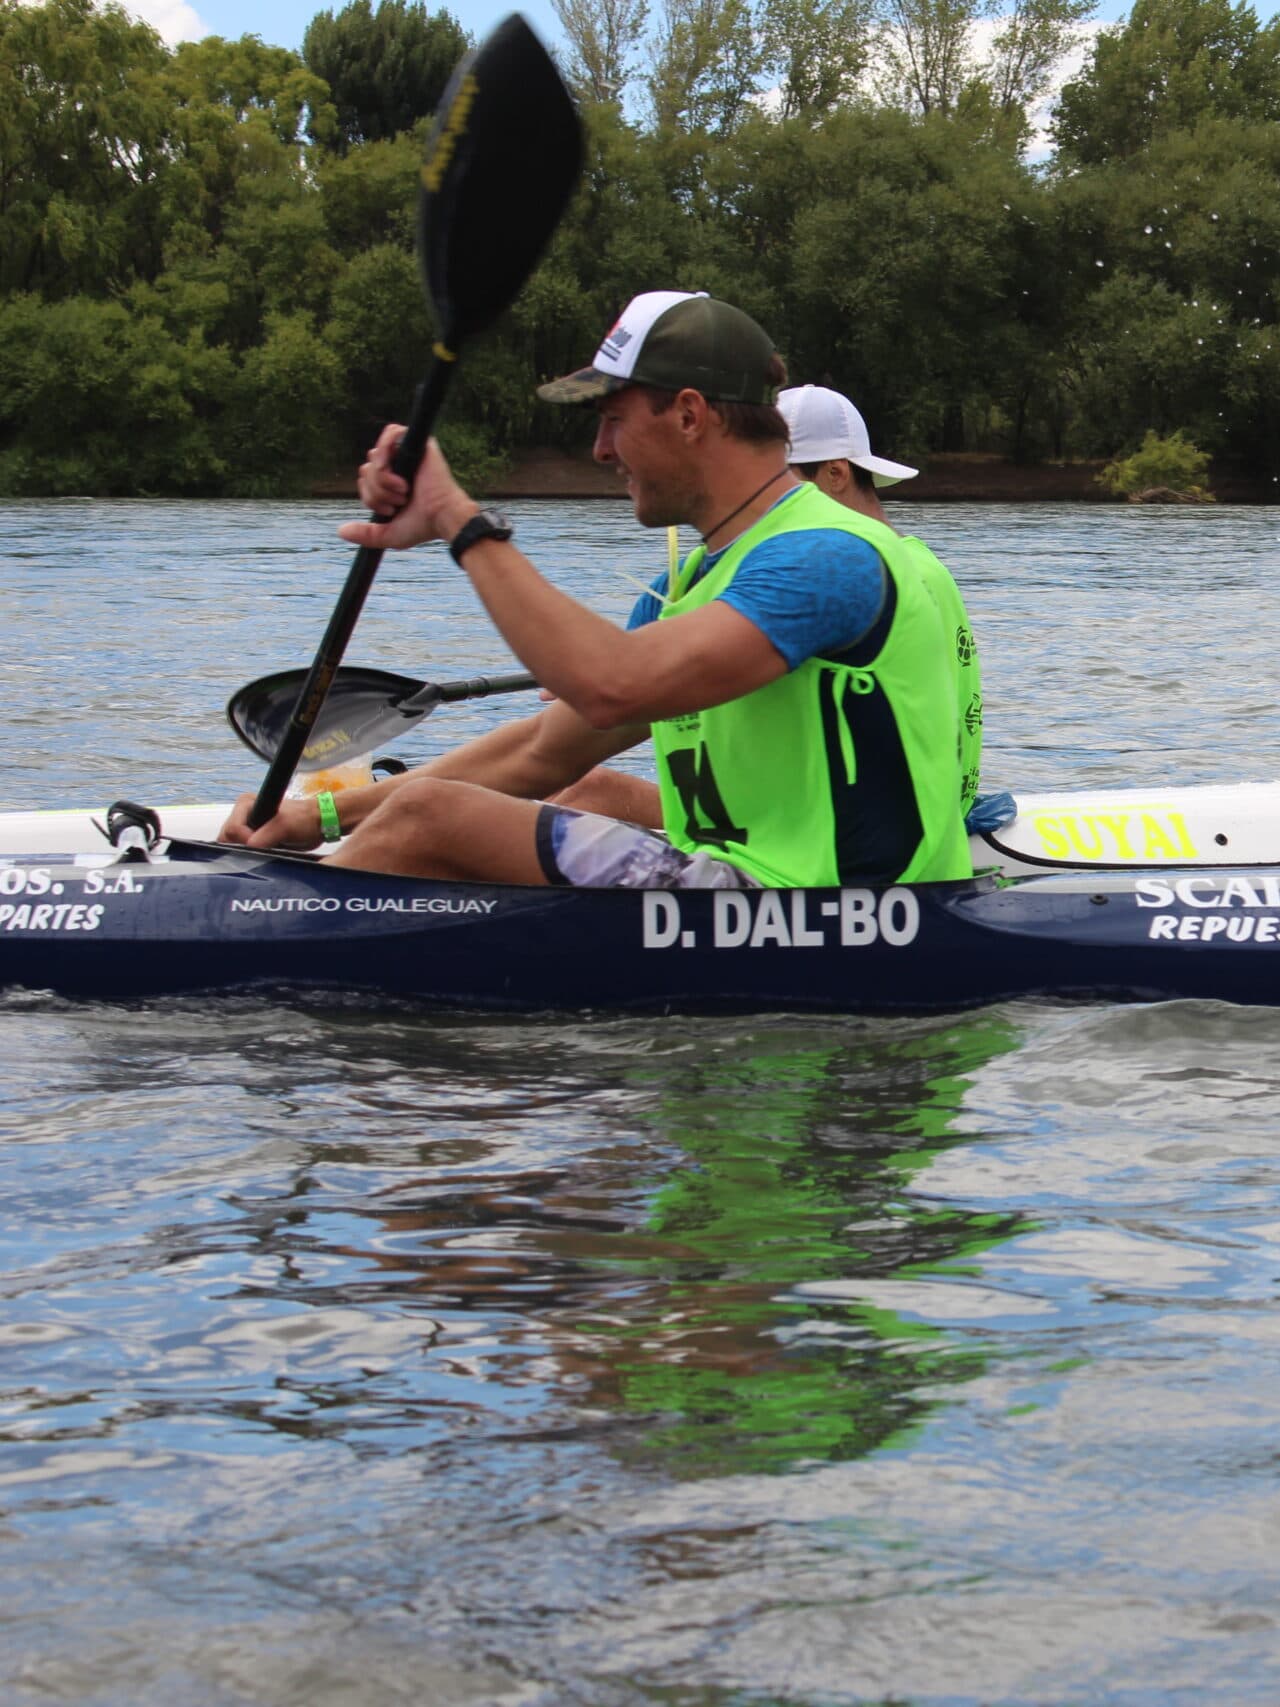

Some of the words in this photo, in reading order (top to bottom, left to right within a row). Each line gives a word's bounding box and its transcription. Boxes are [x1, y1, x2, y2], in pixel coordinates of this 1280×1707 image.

[1034, 813, 1199, 859] SUYAI
[83, 869, 144, 894] S.A.
[231, 897, 340, 912] NAUTICO
[345, 897, 498, 914] GUALEGUAY
[642, 889, 697, 949] D.
[713, 886, 921, 949] DAL-BO
